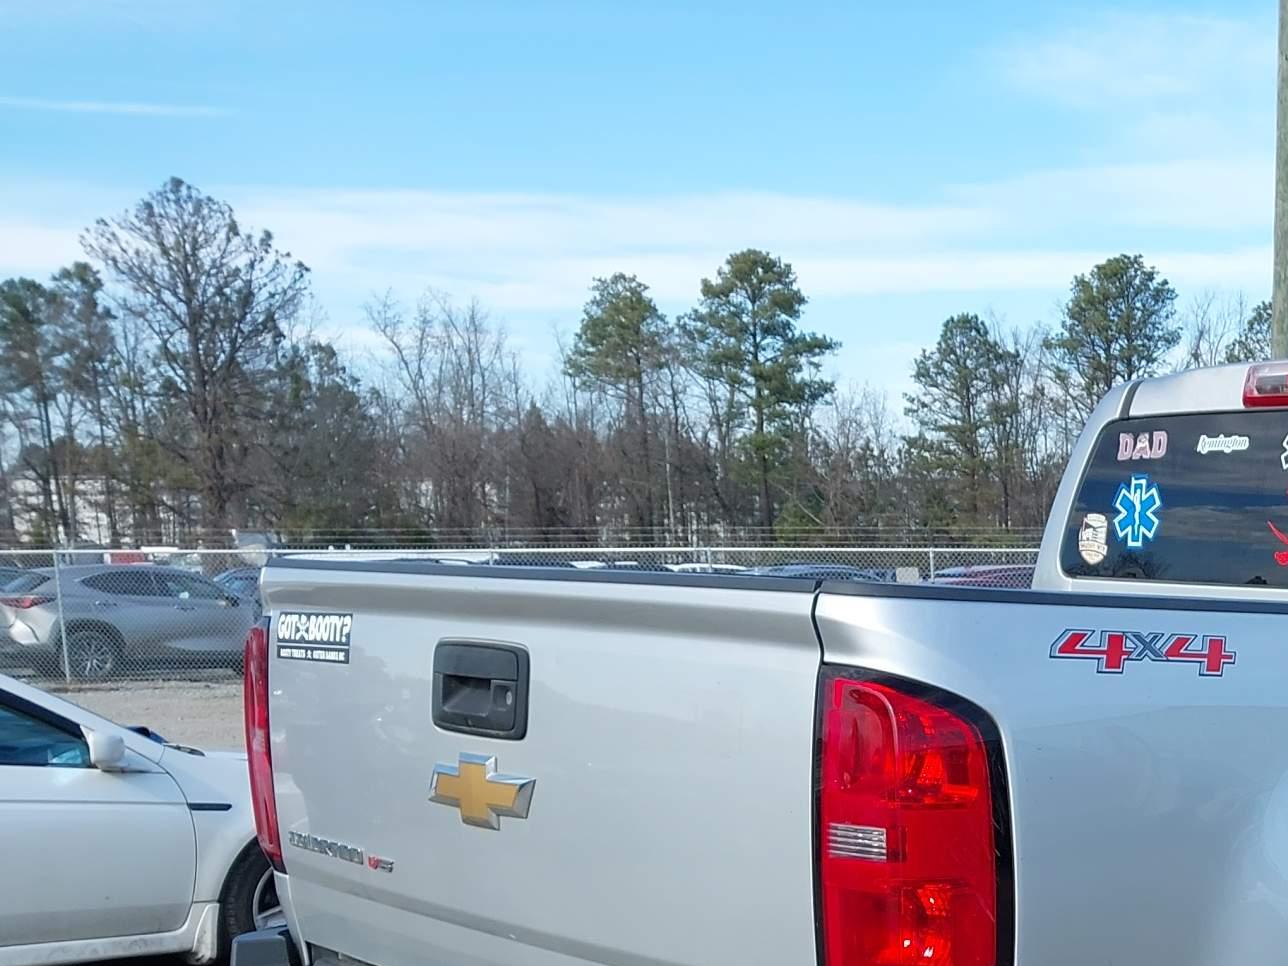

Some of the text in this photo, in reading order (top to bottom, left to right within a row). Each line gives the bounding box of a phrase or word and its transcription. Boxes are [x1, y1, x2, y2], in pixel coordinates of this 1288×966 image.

[1117, 430, 1168, 461] DAD
[1197, 434, 1249, 454] Remington
[278, 614, 352, 643] GOT BOOTY?
